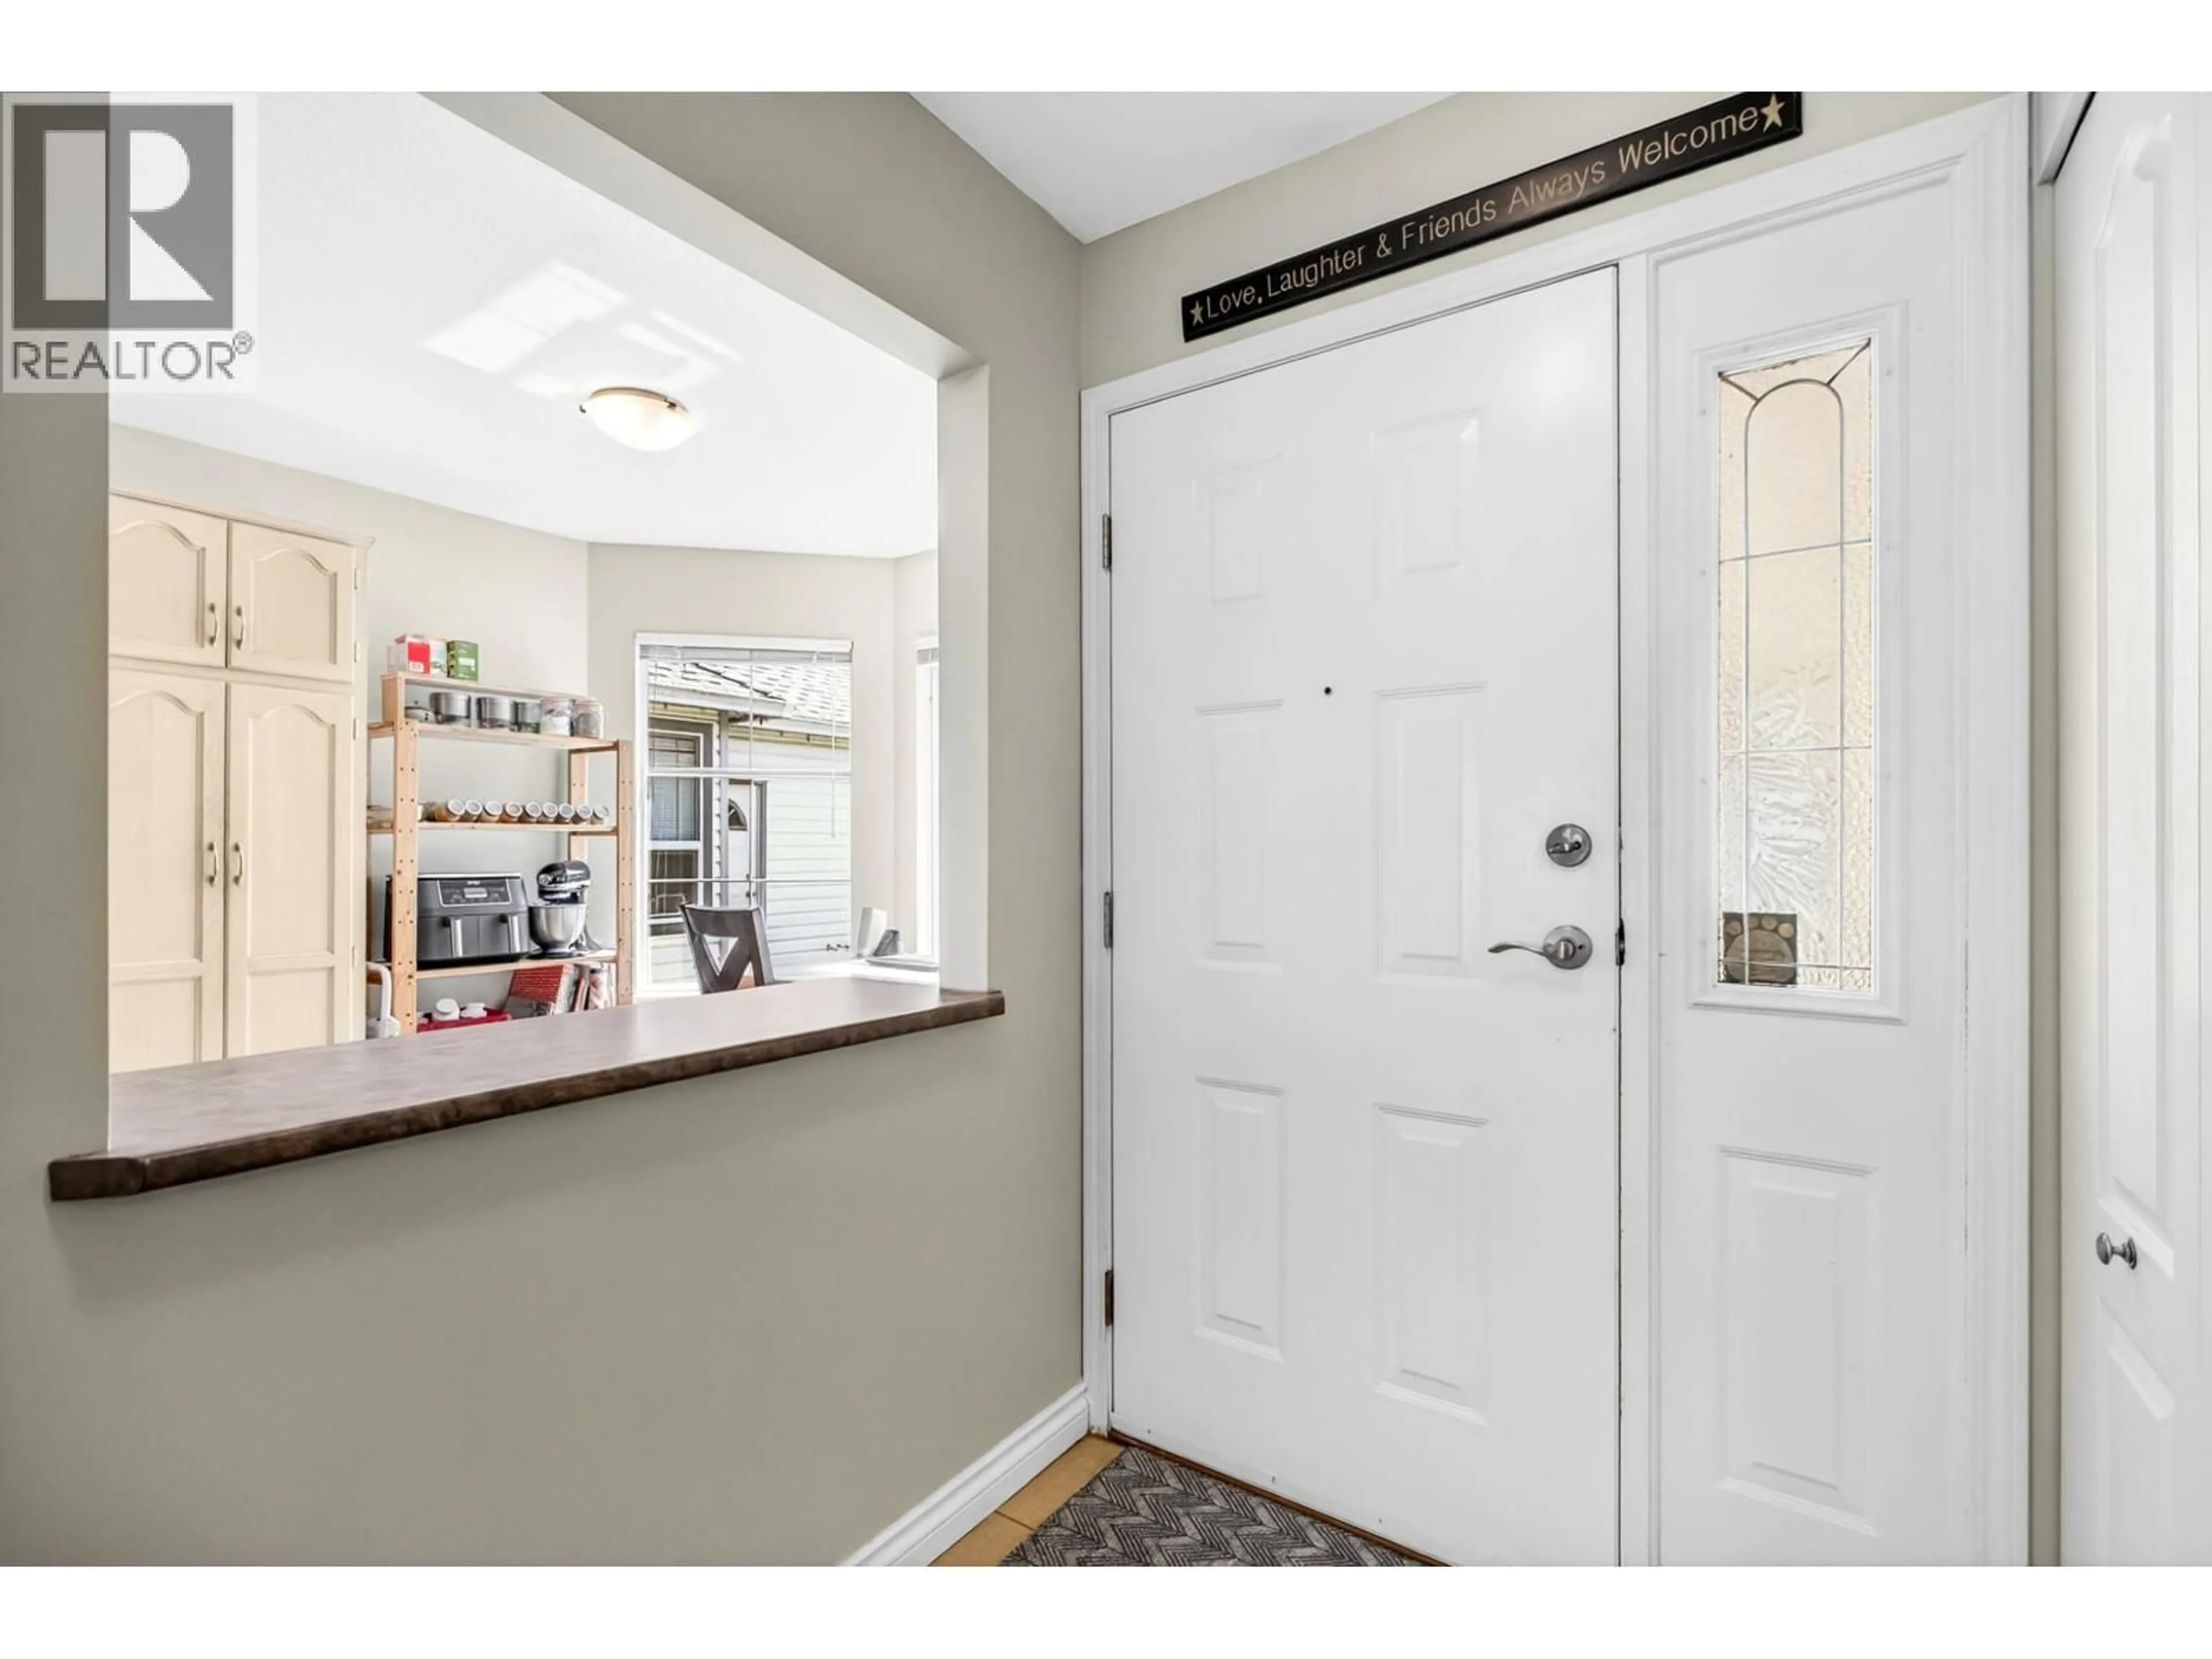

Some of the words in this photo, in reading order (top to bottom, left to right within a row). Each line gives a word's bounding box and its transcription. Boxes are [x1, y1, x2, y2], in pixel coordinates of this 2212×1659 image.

[1206, 285, 1263, 319] Love,
[1267, 243, 1366, 297] Laughter
[1376, 233, 1393, 259] &
[1401, 199, 1497, 250] Friends
[1508, 160, 1605, 214] Always
[1618, 106, 1759, 173] Welcome
